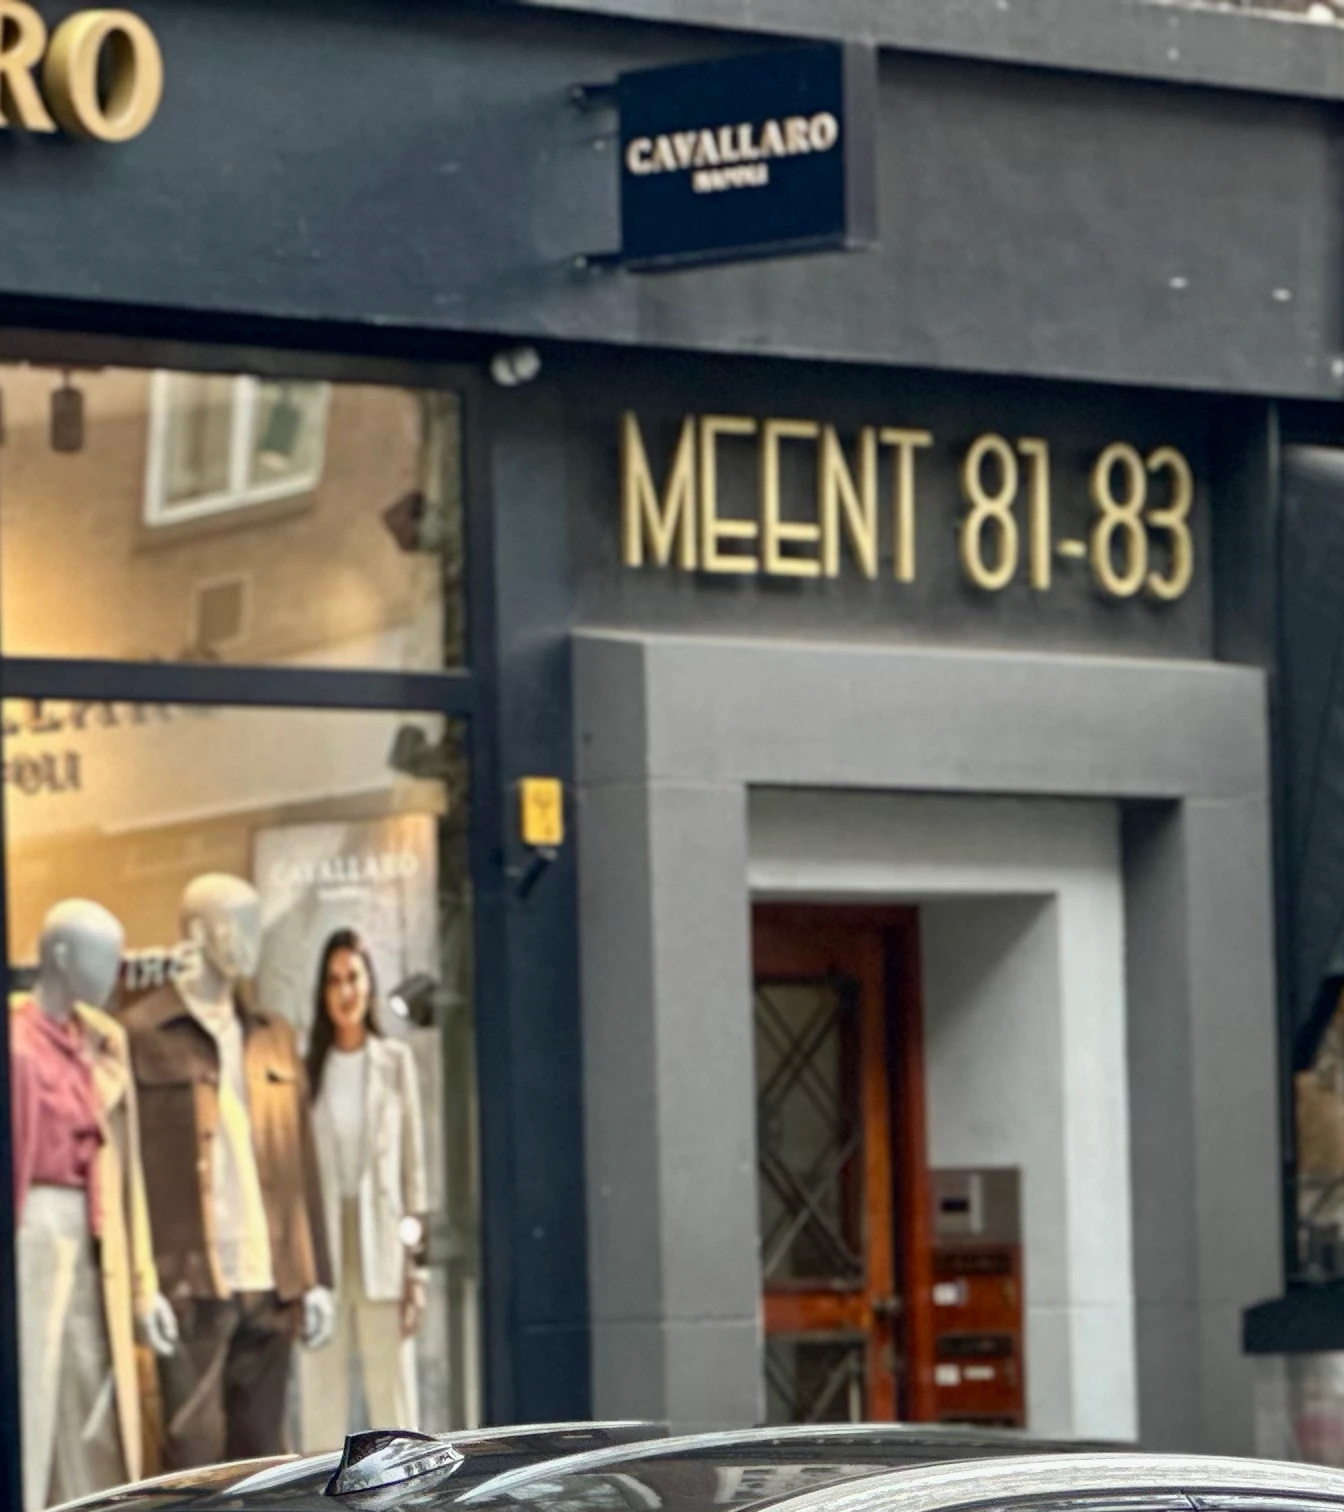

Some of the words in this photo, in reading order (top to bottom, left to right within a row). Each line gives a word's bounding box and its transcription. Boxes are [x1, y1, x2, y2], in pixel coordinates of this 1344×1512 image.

[626, 112, 839, 175] CAVALLARO
[622, 410, 933, 583] MEENT
[961, 433, 1195, 599] 81-83
